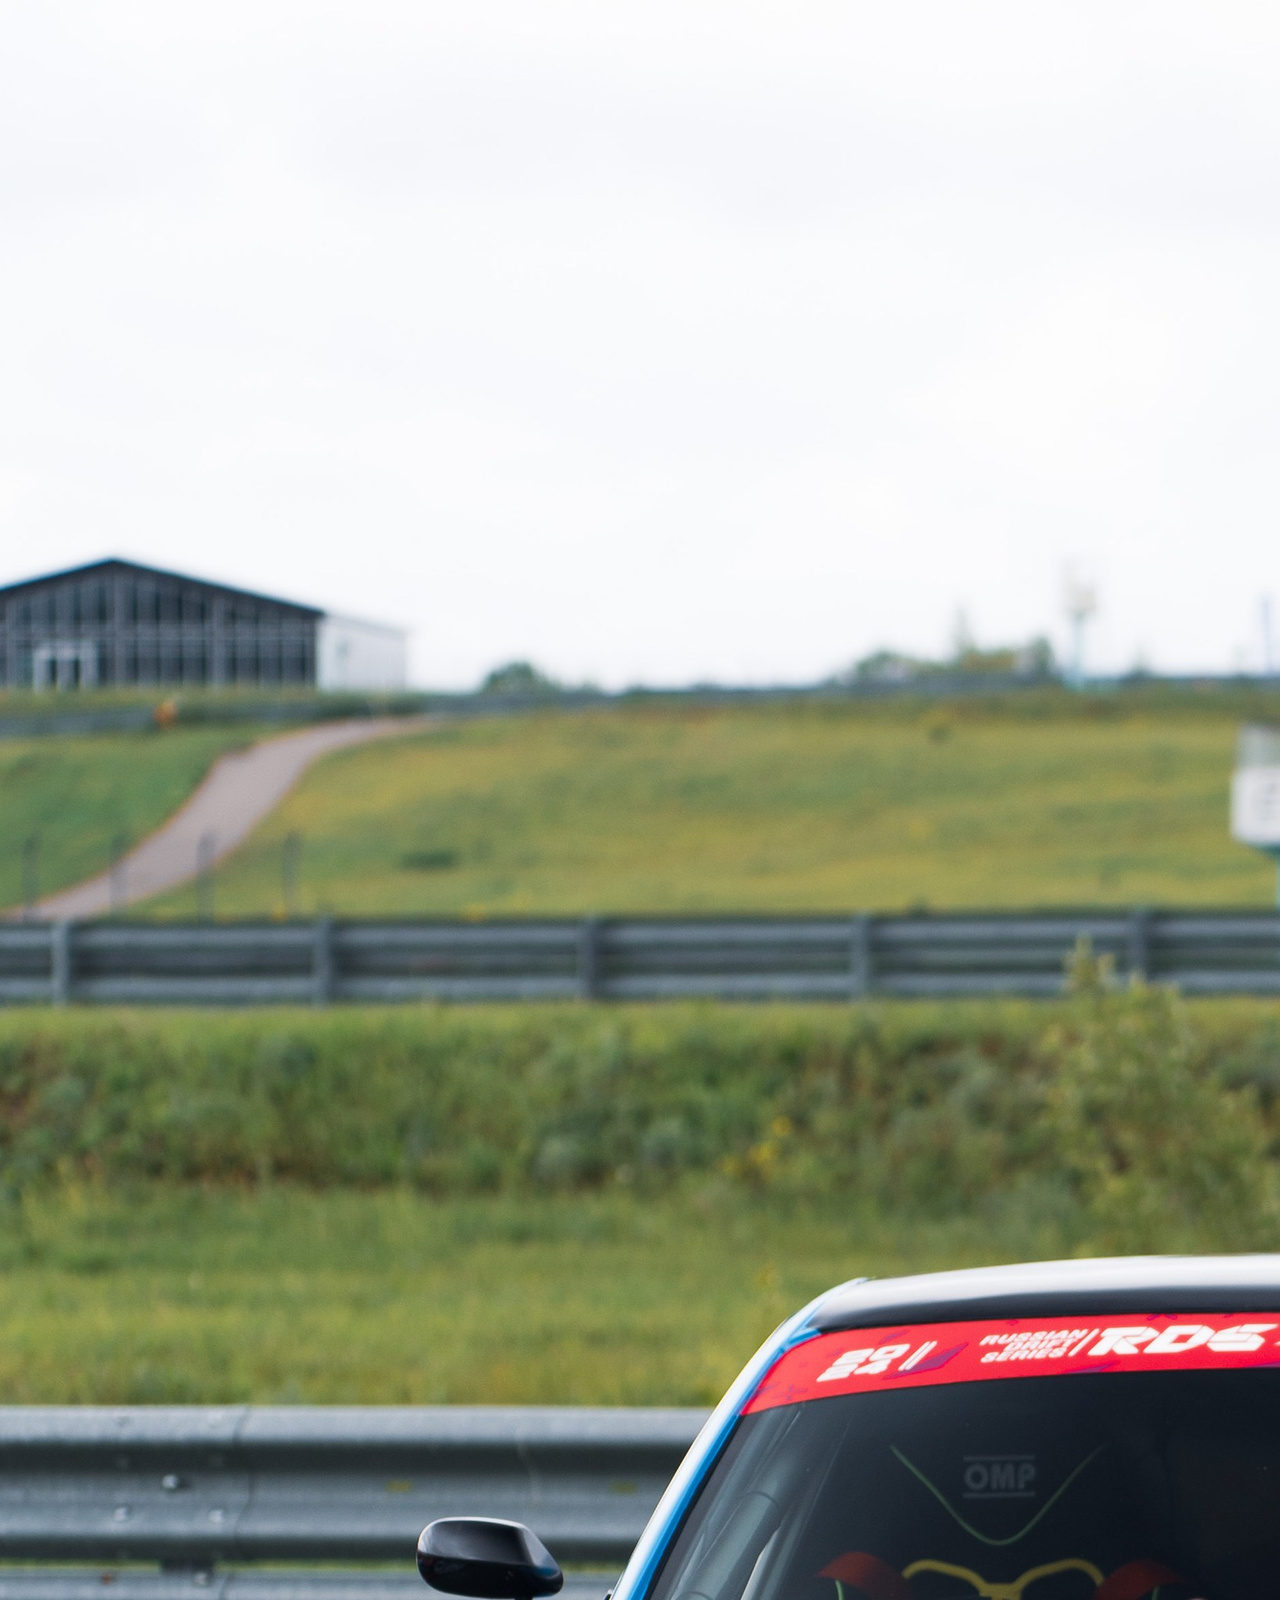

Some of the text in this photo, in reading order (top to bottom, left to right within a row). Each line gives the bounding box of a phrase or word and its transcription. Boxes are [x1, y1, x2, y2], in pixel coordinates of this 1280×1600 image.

[979, 1328, 1089, 1346] RUSSIAN
[1003, 1338, 1078, 1353] DRIFT
[1087, 1323, 1279, 1356] RDS
[980, 1346, 1068, 1363] SERIES
[963, 1462, 1036, 1490] OMP
